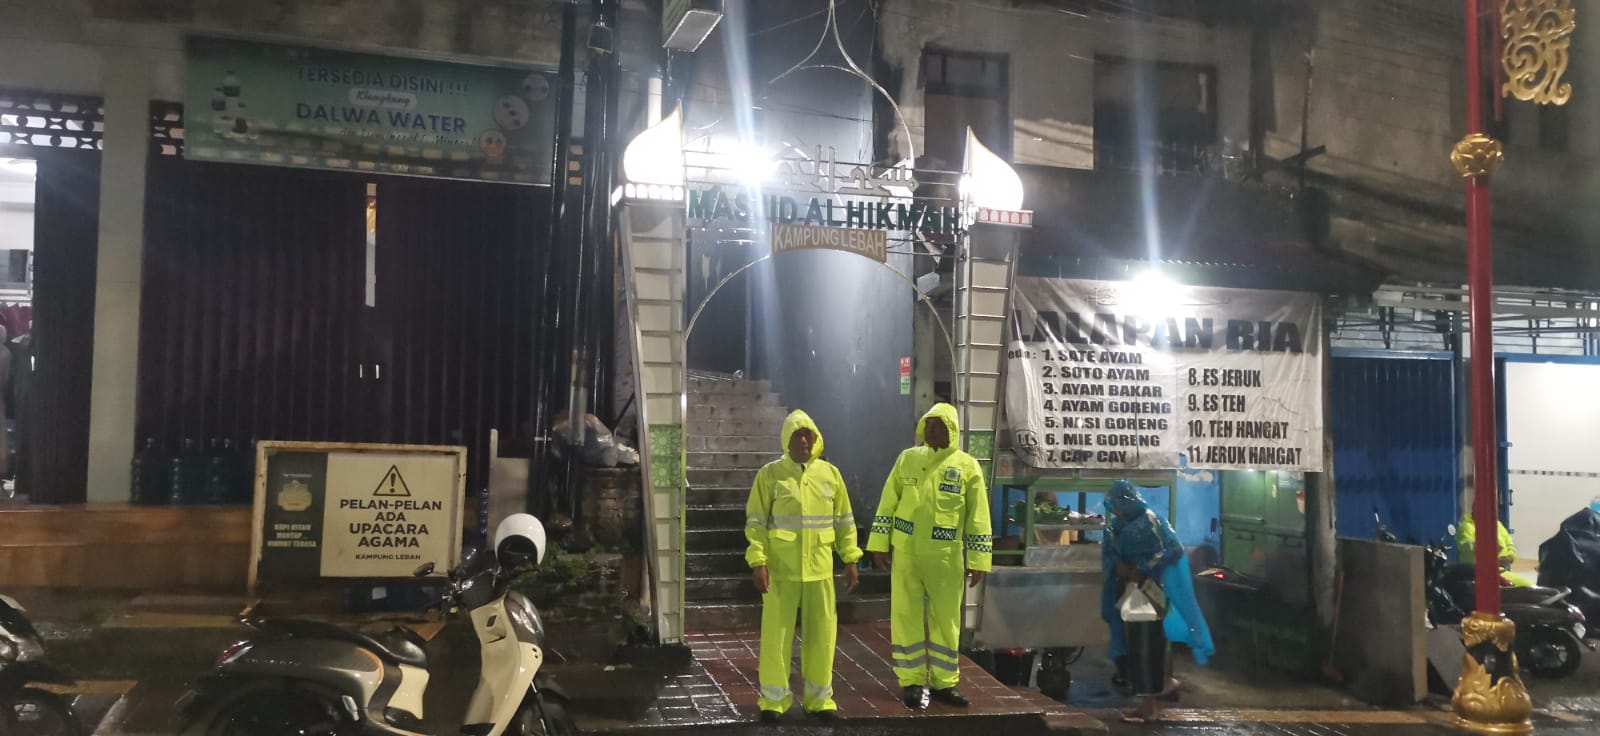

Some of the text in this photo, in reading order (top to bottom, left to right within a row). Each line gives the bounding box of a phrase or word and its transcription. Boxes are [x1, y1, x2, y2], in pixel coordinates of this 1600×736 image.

[297, 66, 384, 88] TERSEDIA
[390, 74, 443, 95] DISINI
[296, 103, 466, 134] DALWA WATER
[1011, 310, 1302, 353] LALAPAN RIA
[1042, 349, 1054, 361] 1.
[1058, 350, 1096, 363] SATE
[1099, 351, 1142, 364] AYAM
[1042, 366, 1149, 380] 2. SOTO AYAM
[1203, 368, 1219, 386] ES
[1221, 369, 1261, 388] JERUK
[1043, 382, 1162, 397] 3. AYAM BAKAR
[1044, 400, 1171, 414] 4. AYAM GORENG
[1188, 393, 1245, 413] 9. ES TEH
[1045, 416, 1168, 430] 5. NASI GORENG
[1188, 419, 1289, 439] 10. TEH HANGAT
[1045, 433, 1160, 447] 6. MIE GORENG
[1047, 450, 1127, 463] 7. CAP CAY
[1187, 445, 1302, 465] 11. JERUK HANGAT
[340, 499, 442, 511] PELAN-PELAN
[375, 511, 406, 522] ADA
[349, 522, 429, 535] UPACARA
[358, 536, 420, 548] AGAMA
